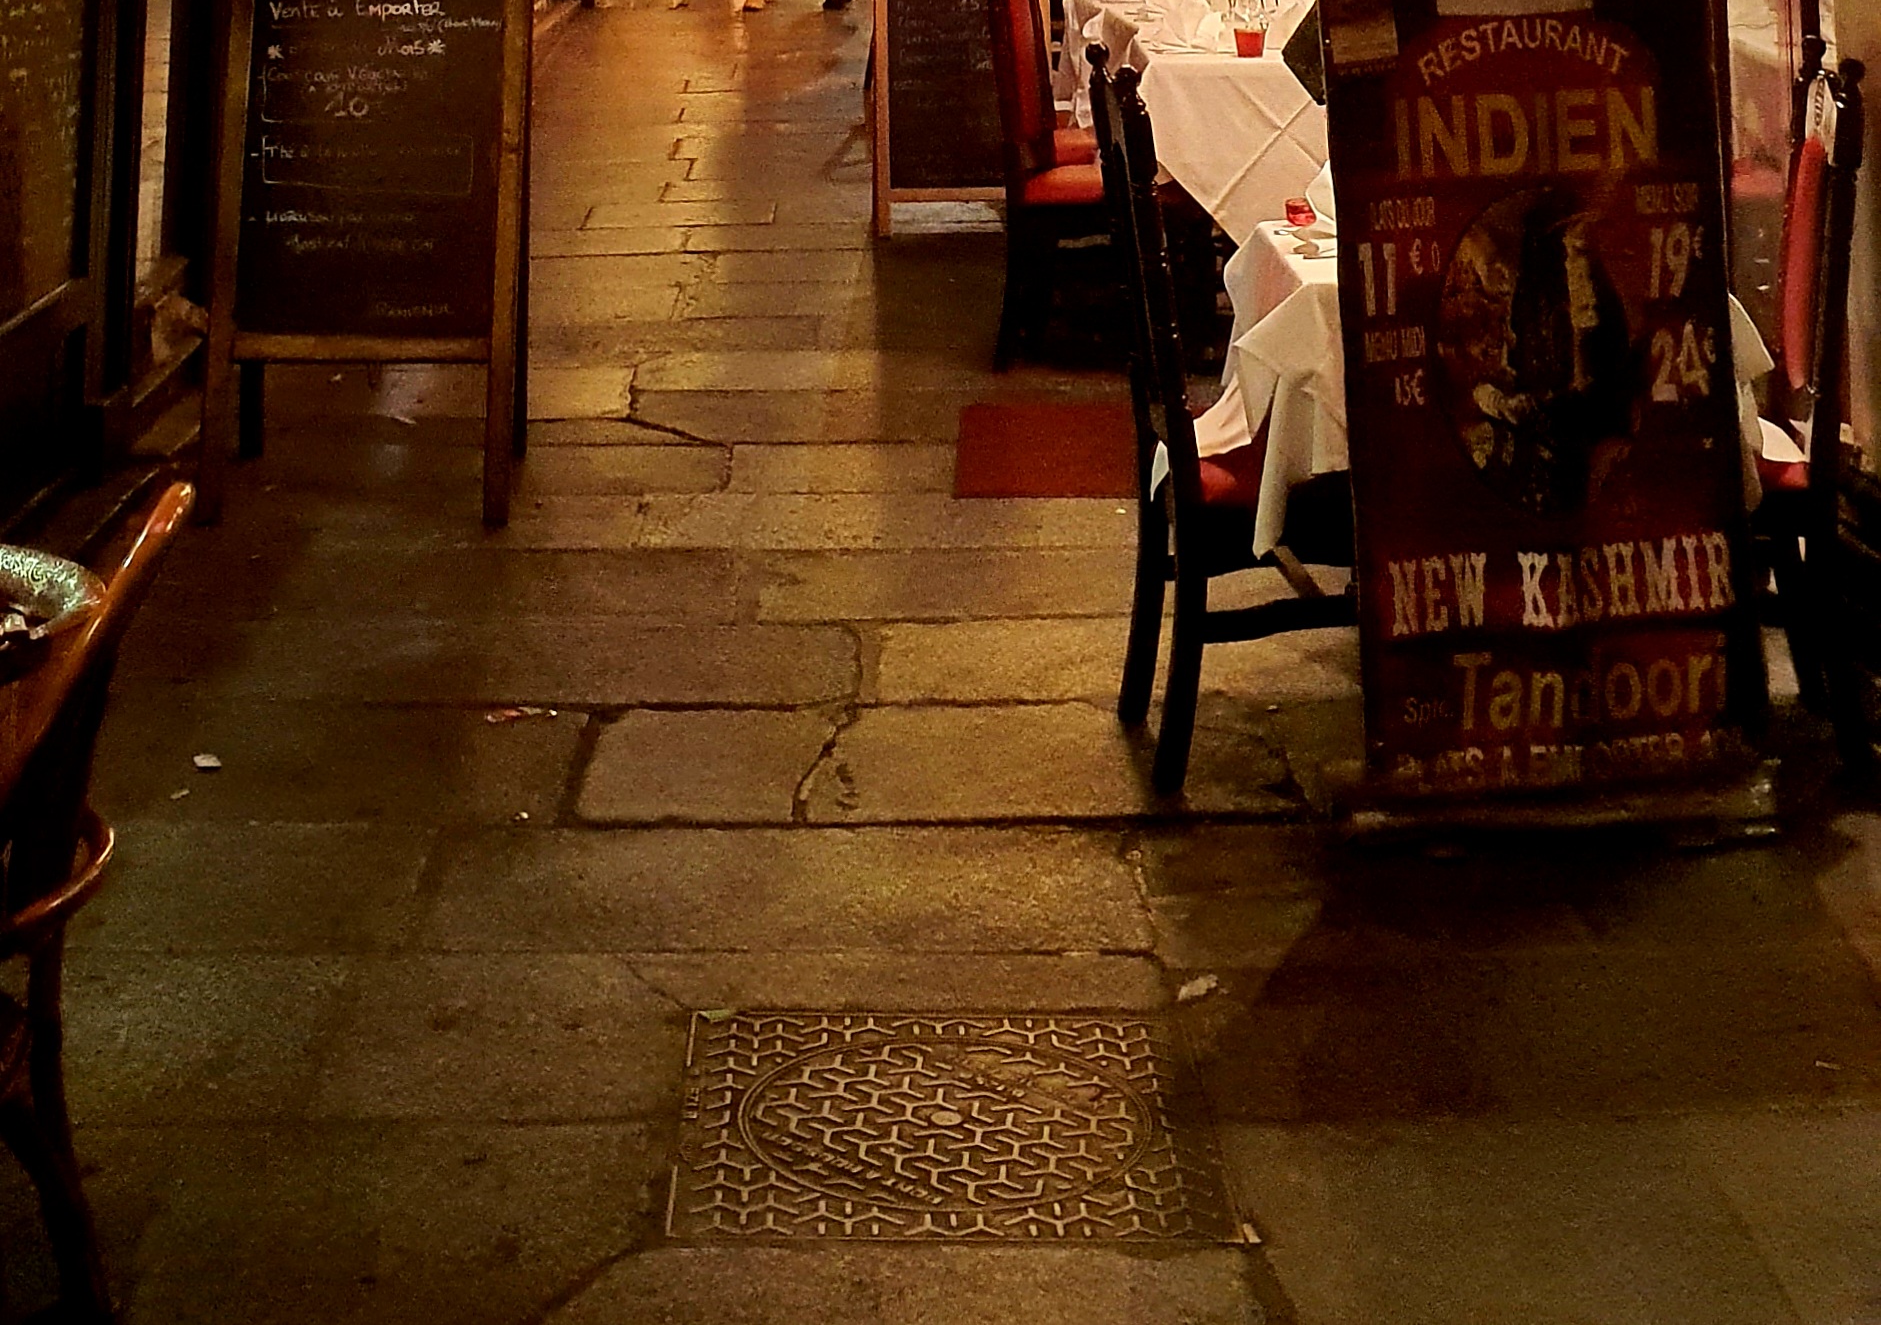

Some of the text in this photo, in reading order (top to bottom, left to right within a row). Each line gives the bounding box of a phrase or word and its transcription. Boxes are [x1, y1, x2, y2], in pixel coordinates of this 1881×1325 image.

[1416, 17, 1629, 87] RESTAURANT
[1396, 85, 1659, 183] INDIEN
[1388, 531, 1736, 637] NEW KASHMIR
[1453, 631, 1728, 731] Tanoori
